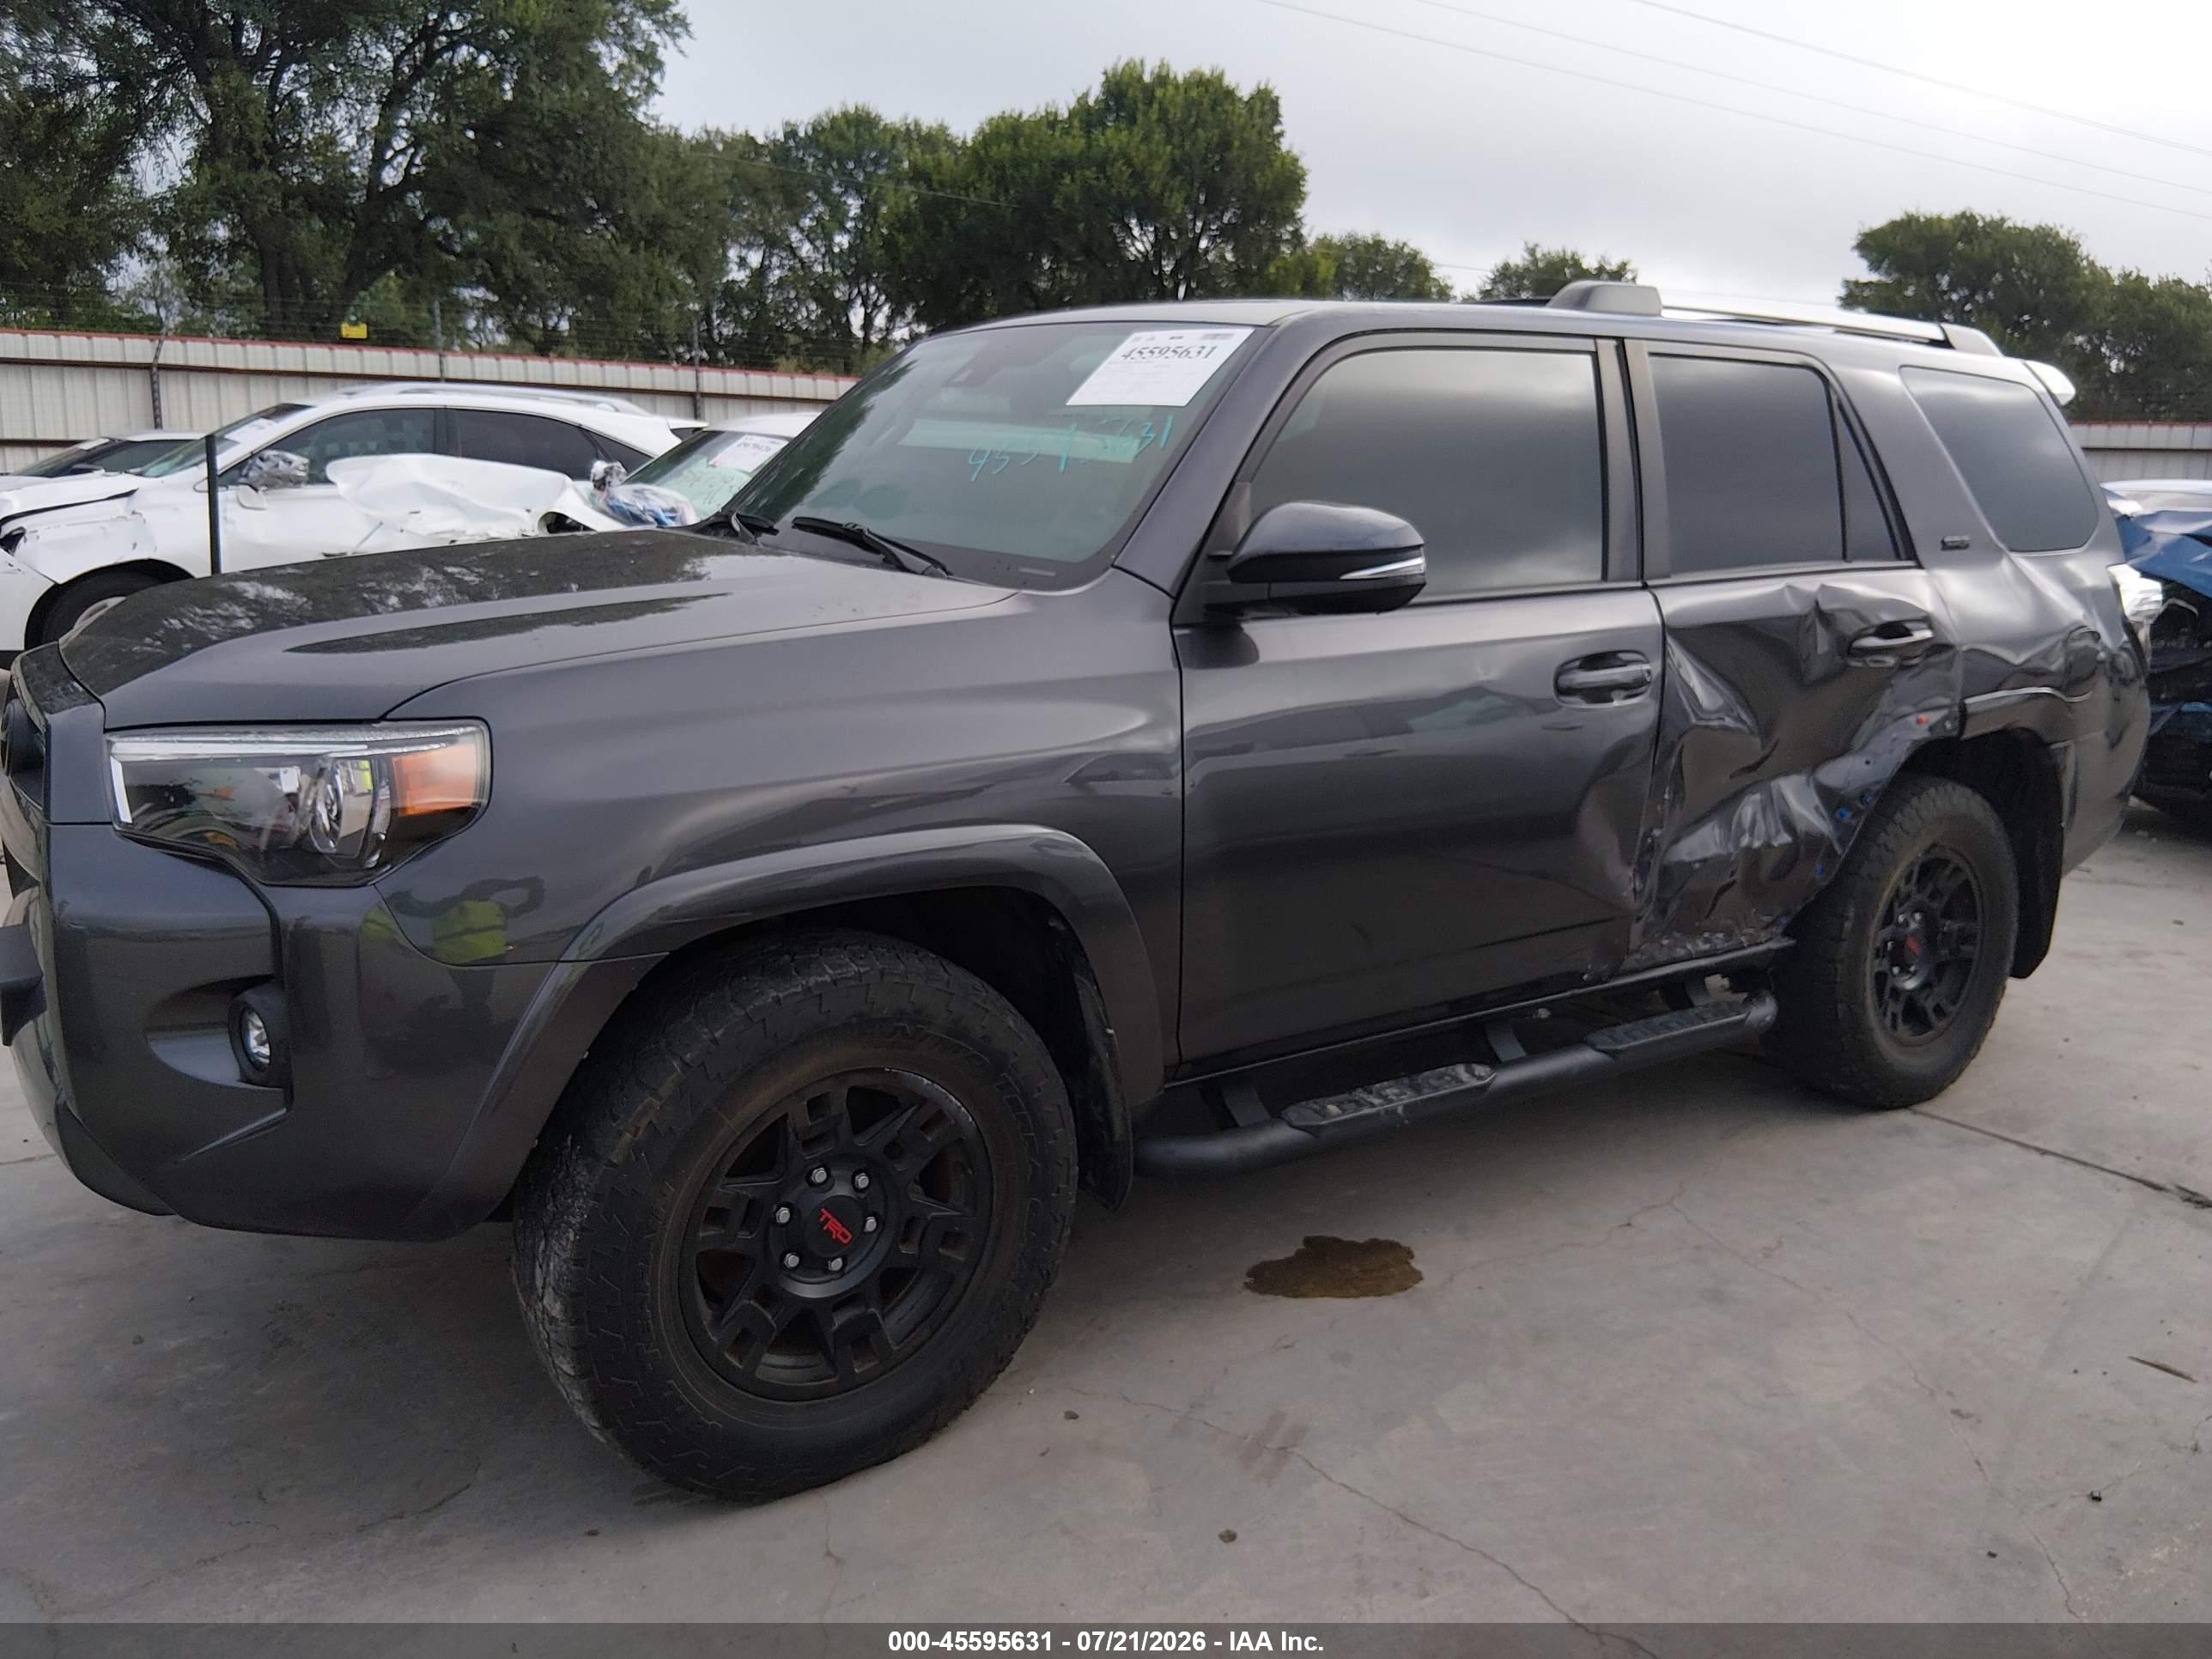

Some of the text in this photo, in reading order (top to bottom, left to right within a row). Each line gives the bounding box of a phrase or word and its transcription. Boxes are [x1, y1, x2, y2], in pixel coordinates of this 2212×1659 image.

[1121, 345, 1218, 360] 45595631
[968, 414, 1174, 483] 4531
[819, 1207, 853, 1244] TRD
